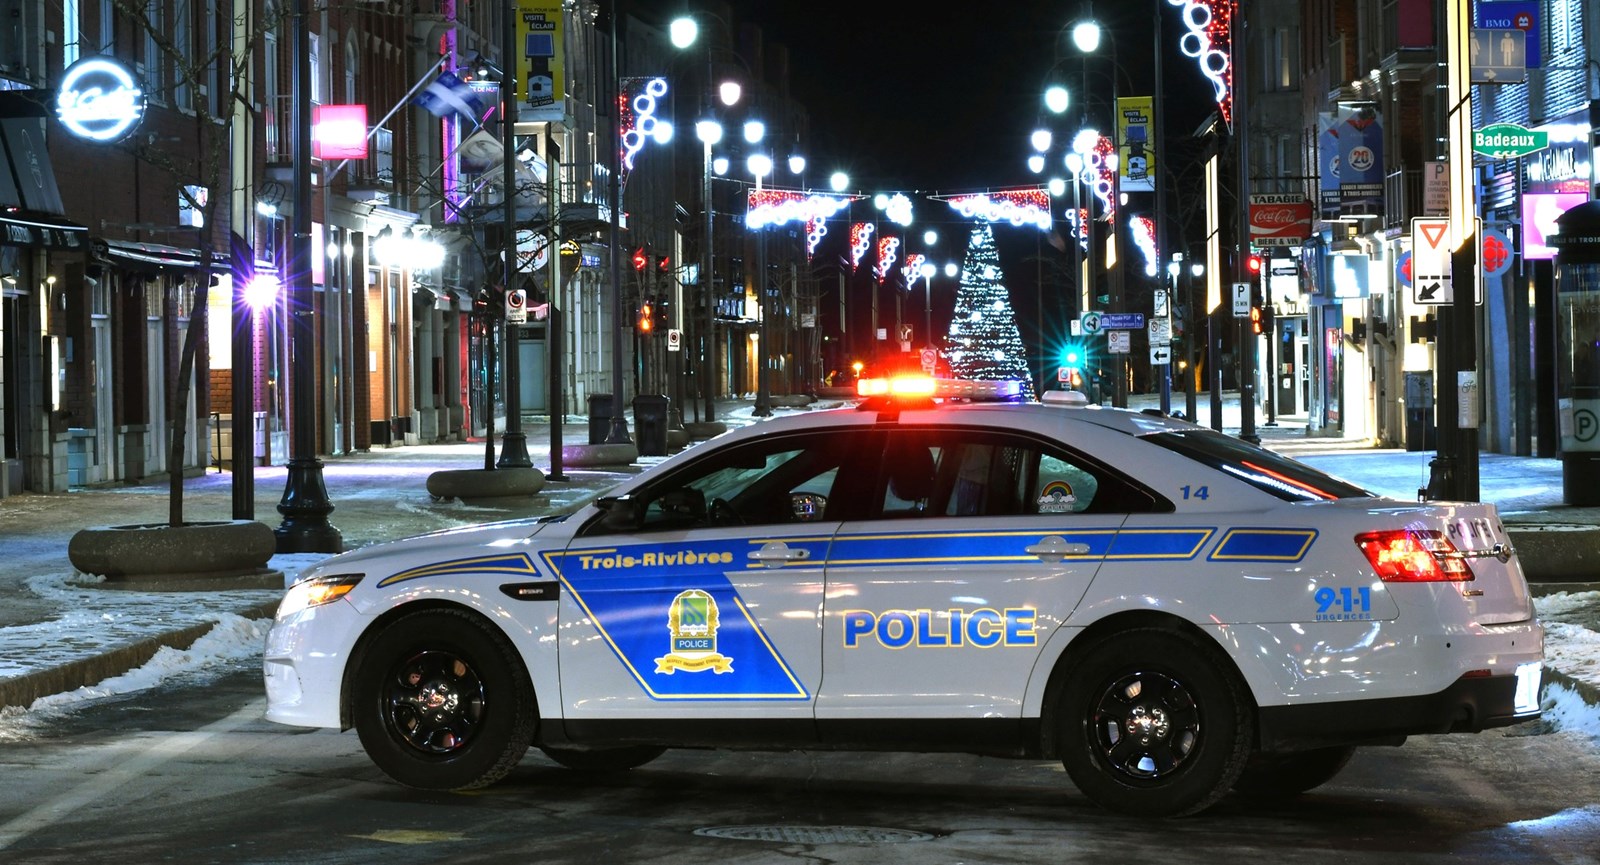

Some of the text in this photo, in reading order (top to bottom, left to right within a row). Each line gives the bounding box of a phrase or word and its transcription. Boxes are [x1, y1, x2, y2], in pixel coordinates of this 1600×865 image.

[1486, 19, 1511, 27] BMO
[1475, 133, 1535, 146] Badeaux
[1353, 150, 1369, 164] 20
[1435, 164, 1444, 179] P
[1253, 195, 1302, 203] TABAGIE
[1254, 209, 1296, 223] Coca-Cola
[1238, 285, 1245, 298] P
[1579, 416, 1591, 435] P
[1180, 485, 1209, 500] 14
[579, 550, 733, 570] Trois-Rivières
[1314, 586, 1371, 613] 9-1-1
[842, 607, 1037, 650] POLICE
[679, 640, 708, 648] POLICE
